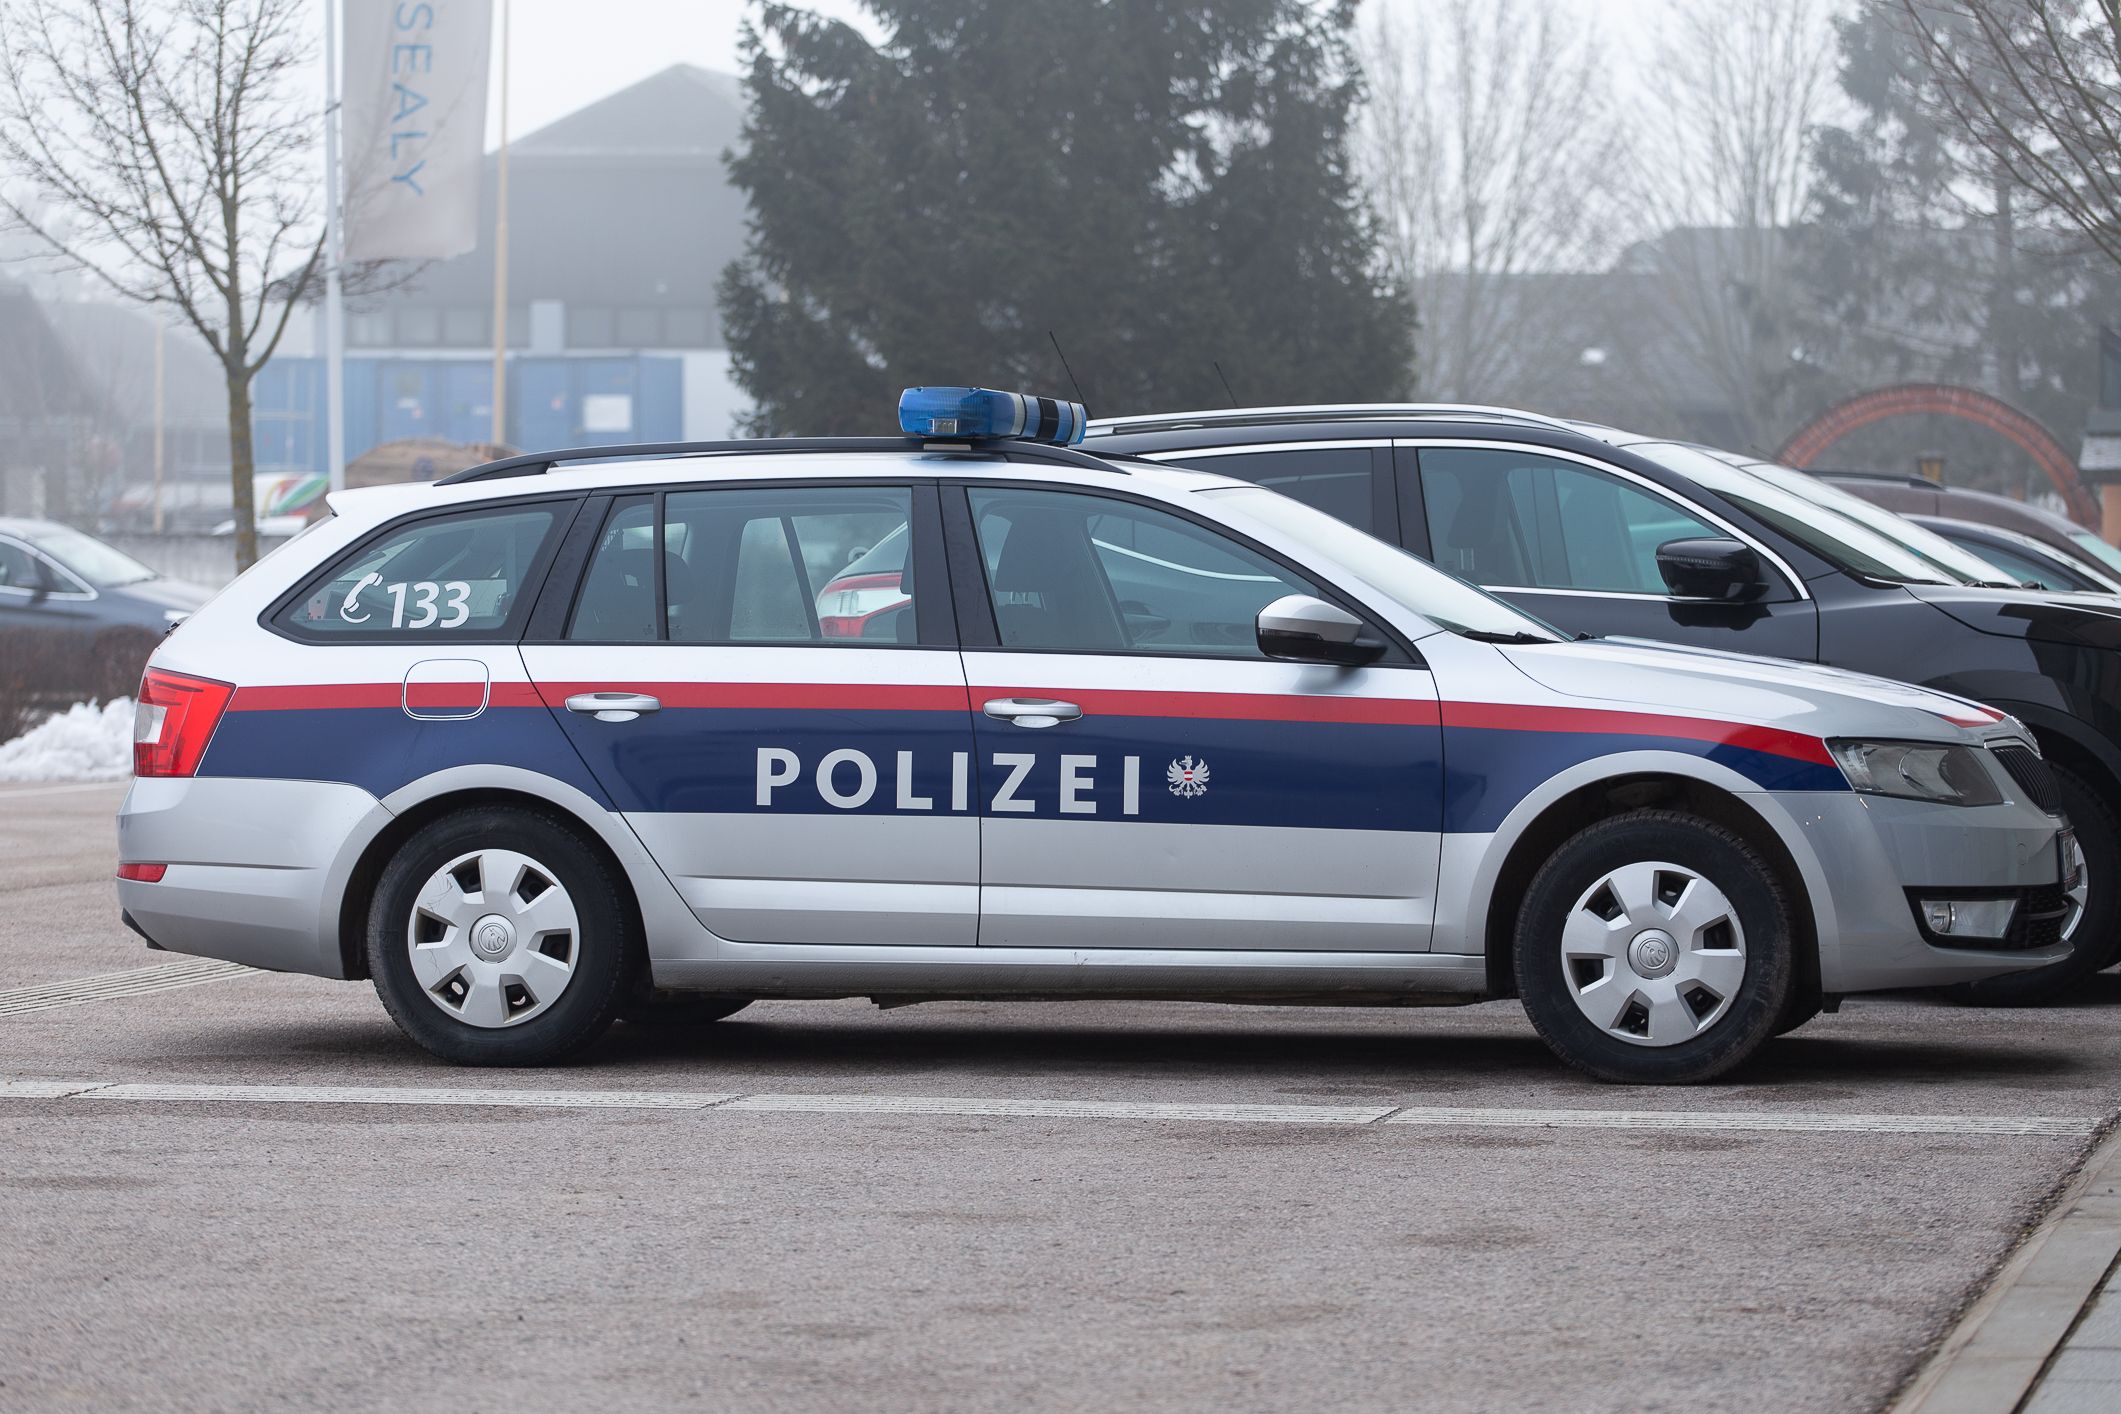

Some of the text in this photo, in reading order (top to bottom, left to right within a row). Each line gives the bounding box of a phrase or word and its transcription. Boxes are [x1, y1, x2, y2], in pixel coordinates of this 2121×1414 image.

[391, 2, 434, 196] SEALY
[387, 581, 471, 629] 133
[756, 747, 1140, 815] POLIZEI
